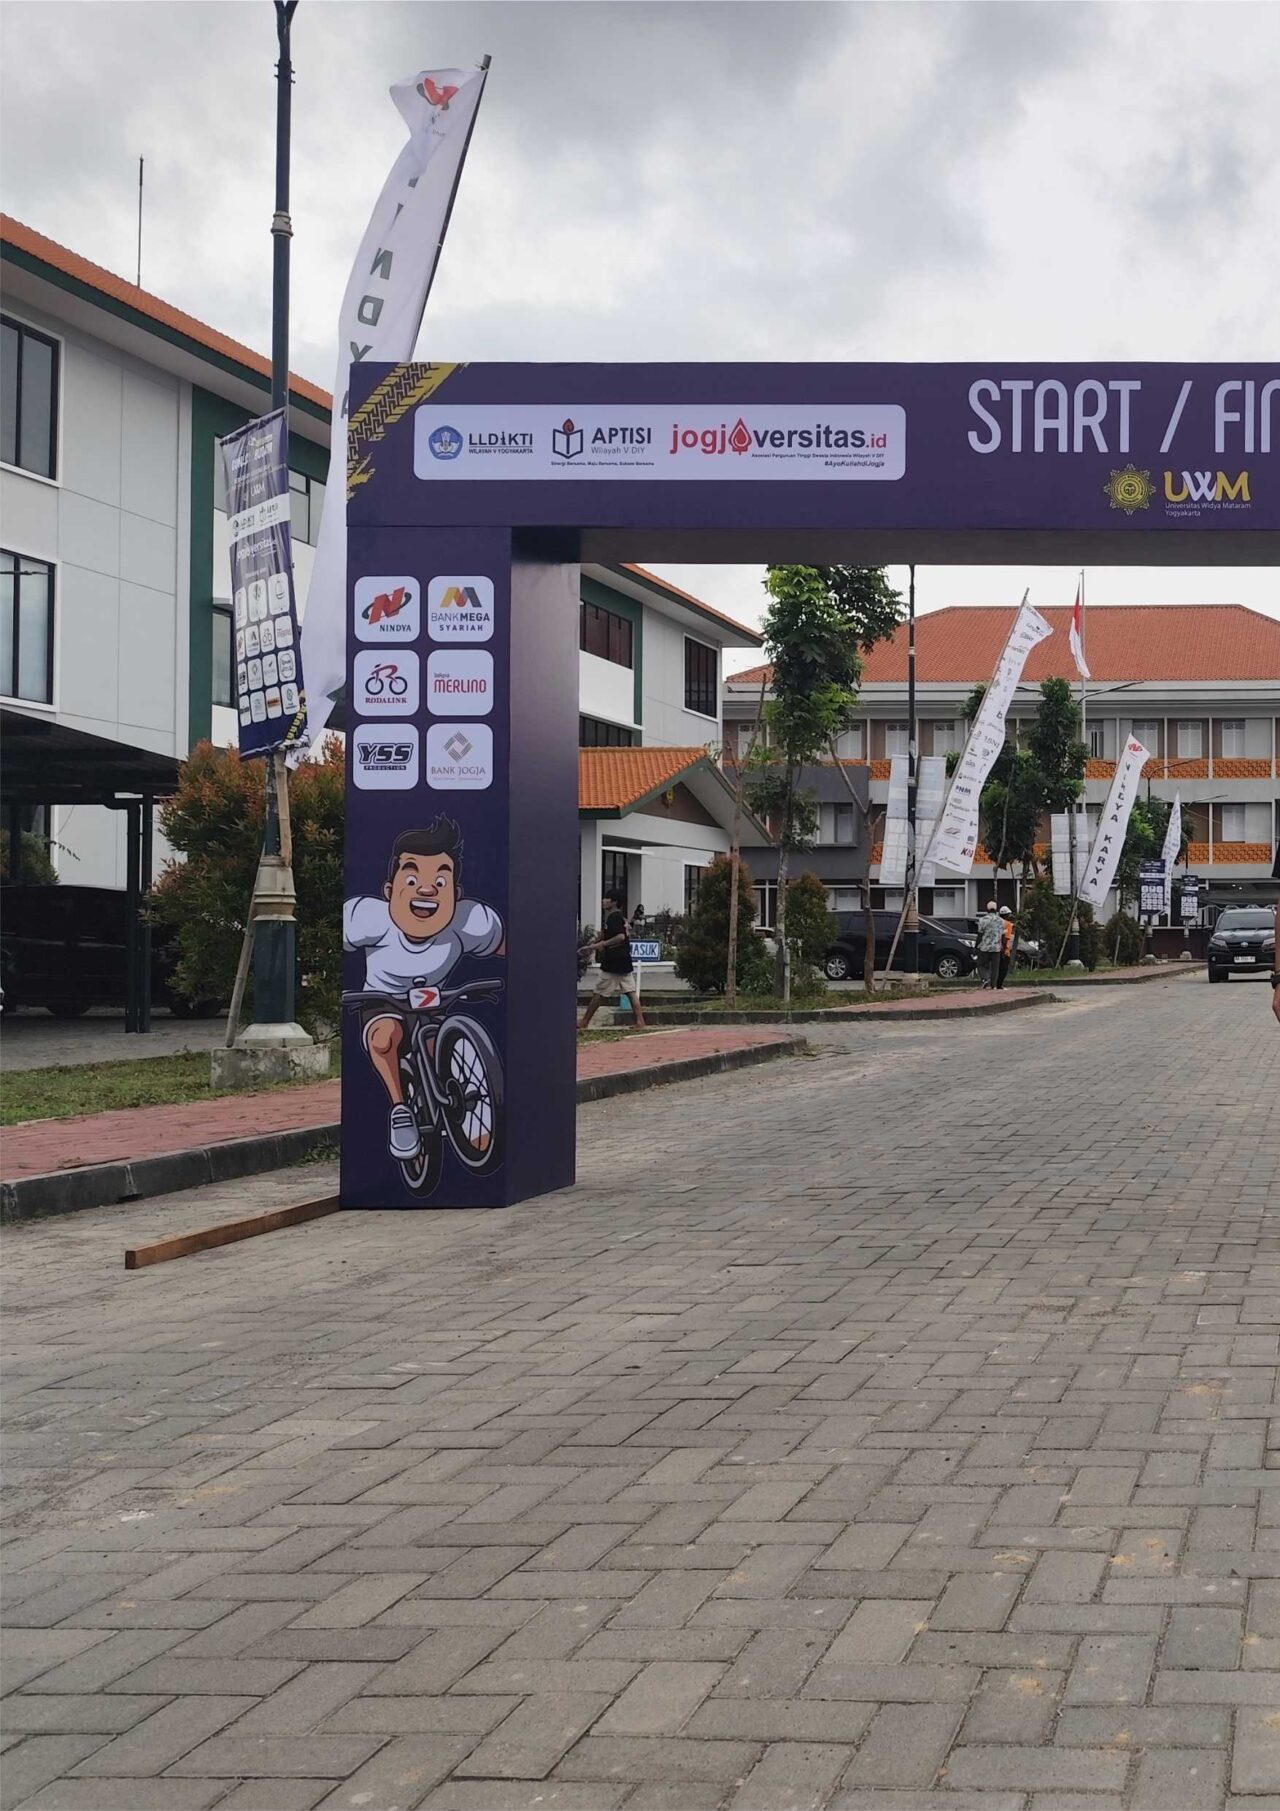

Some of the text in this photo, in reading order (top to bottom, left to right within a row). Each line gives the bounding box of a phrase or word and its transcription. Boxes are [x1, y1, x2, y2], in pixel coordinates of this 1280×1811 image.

[967, 379, 1142, 454] START
[1159, 380, 1193, 454] /
[468, 431, 533, 446] LLDIKTI
[591, 427, 652, 444] APTISI
[591, 446, 646, 454] Wilayah V DIY
[1164, 471, 1251, 502] UWM
[1165, 510, 1201, 518] Yogyakarta
[1201, 502, 1221, 511] Widya
[379, 624, 412, 632] NINDYA
[439, 624, 483, 632] SYARIAH
[433, 679, 487, 694] MERLINO
[357, 742, 414, 765] YSS
[431, 766, 487, 776] BANK JOGJA
[1089, 834, 1113, 887] KARYA
